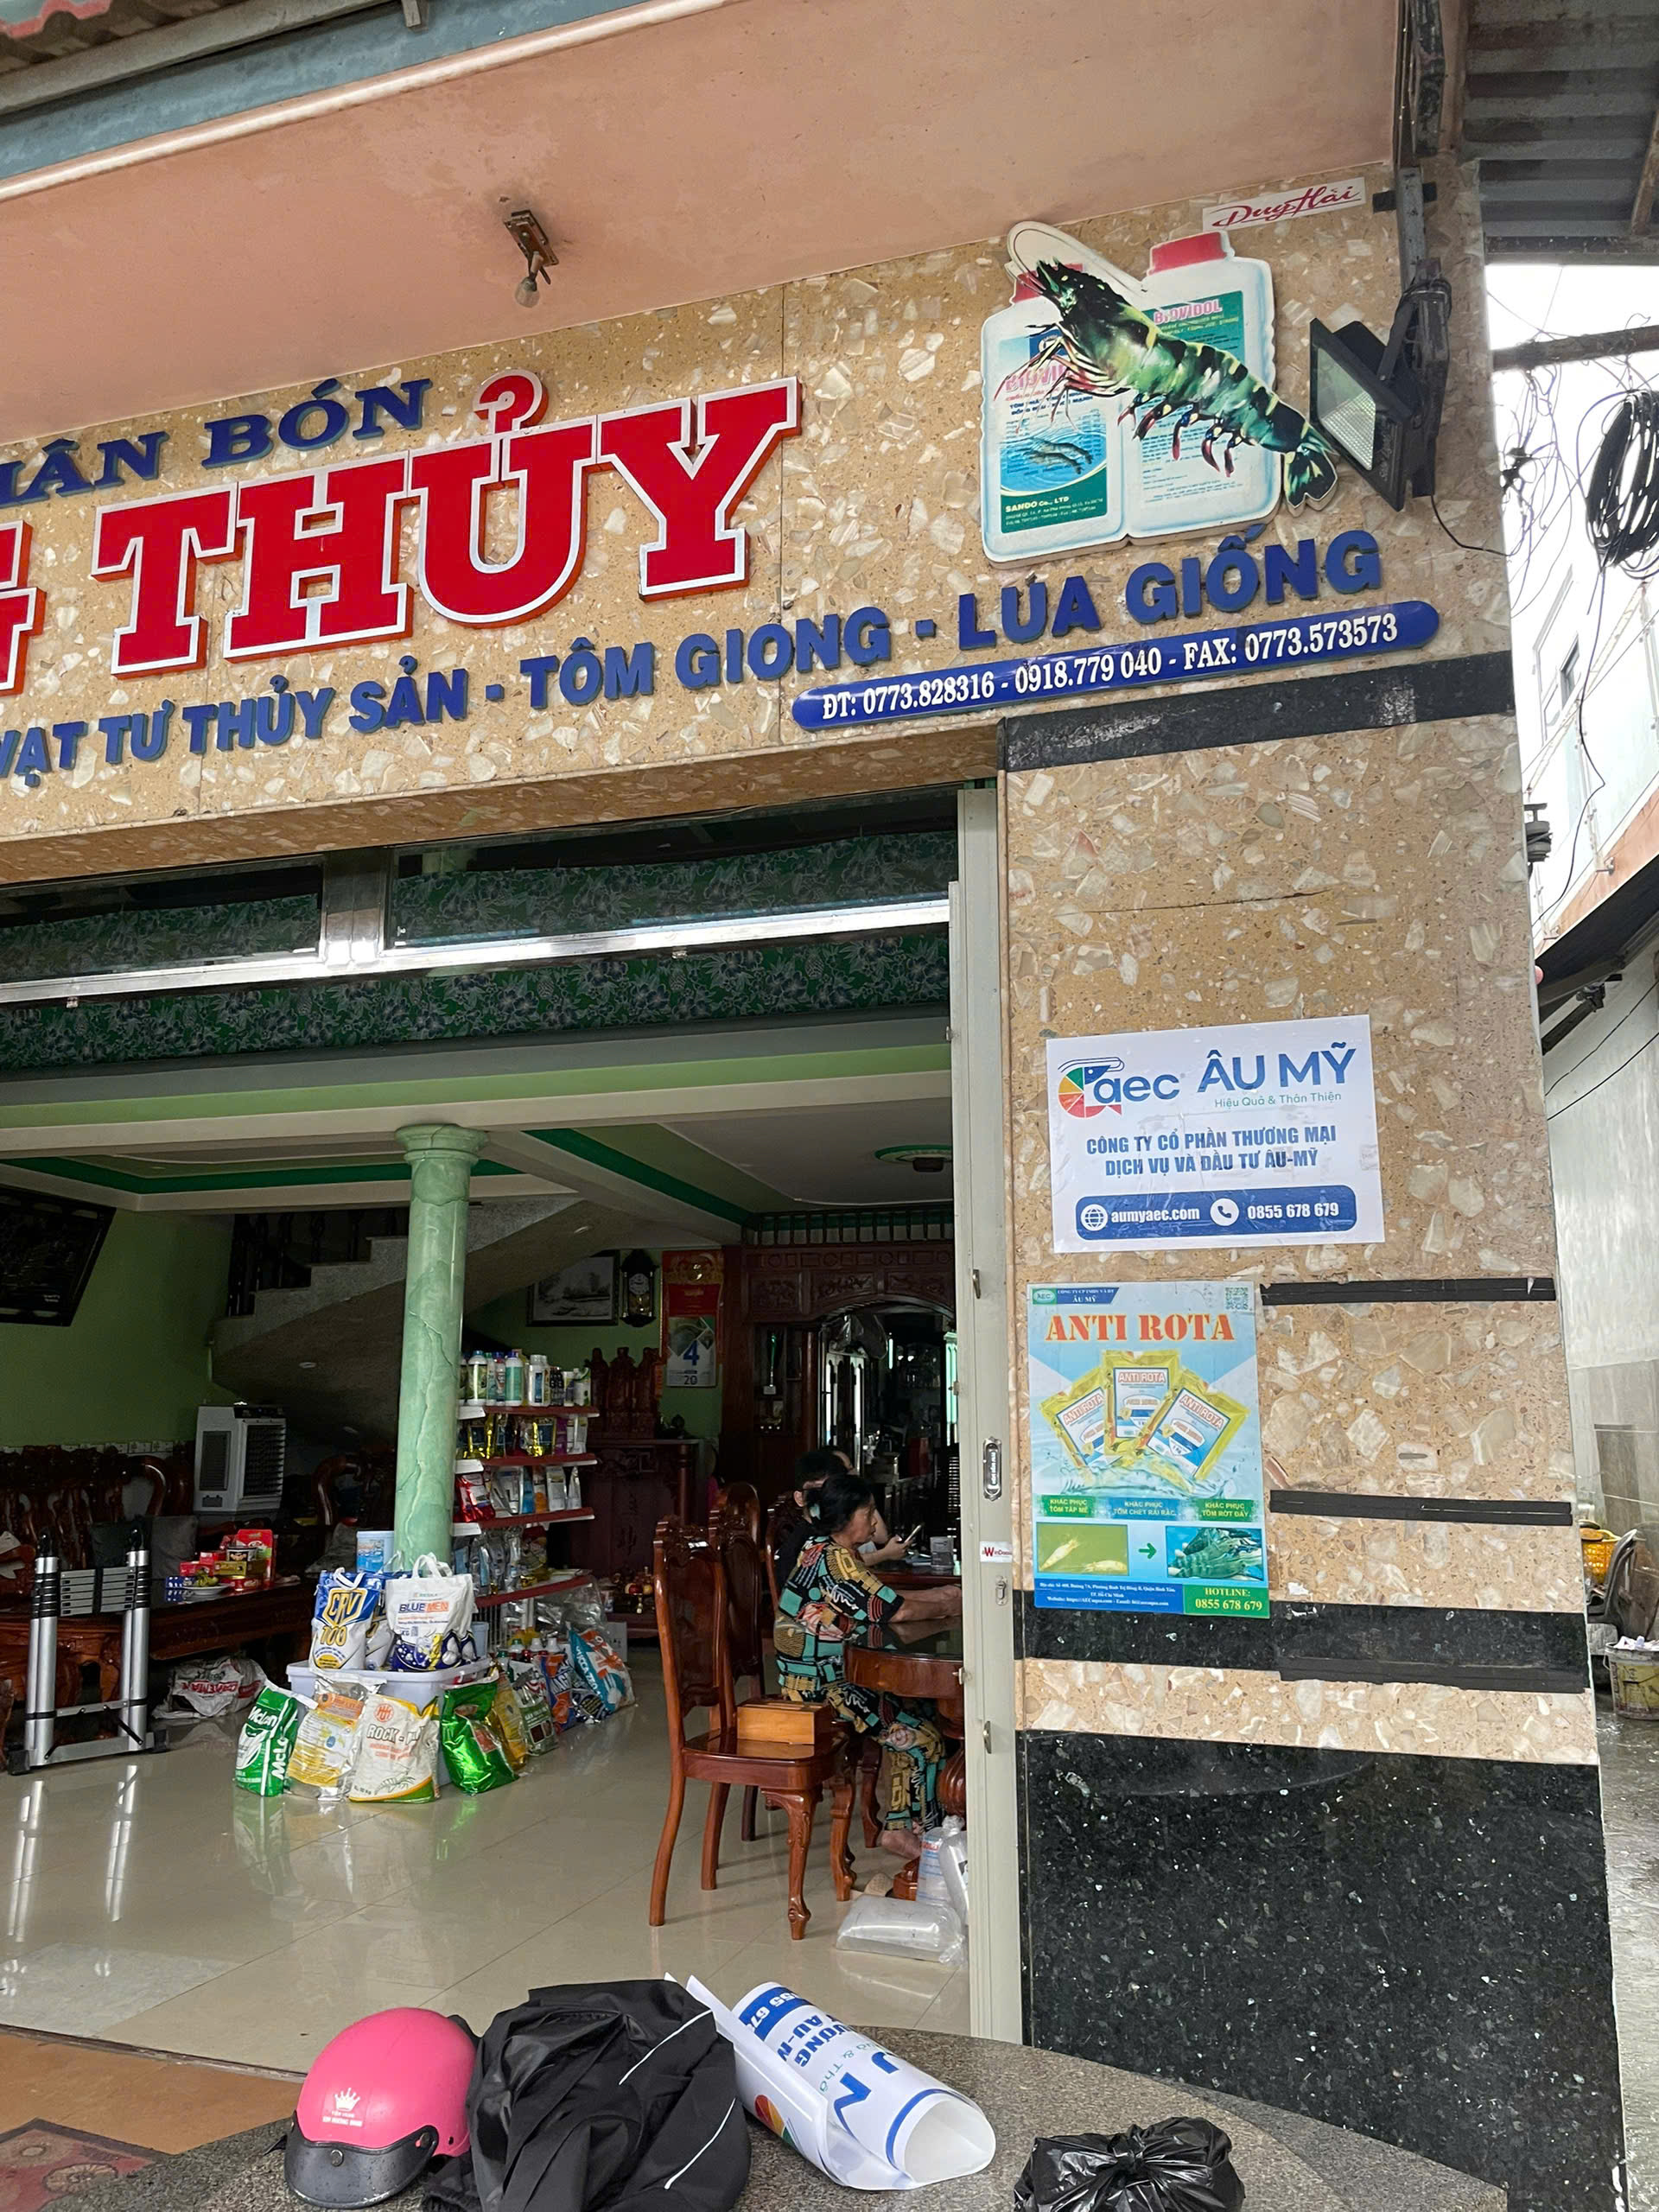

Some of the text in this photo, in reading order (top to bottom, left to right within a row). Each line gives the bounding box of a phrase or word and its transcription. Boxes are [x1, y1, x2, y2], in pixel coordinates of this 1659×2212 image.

[201, 378, 433, 469] BÓN
[1005, 501, 1038, 513] SANDO
[91, 369, 803, 680] THỦY
[99, 699, 175, 764] TƯ
[182, 675, 335, 754] THỦY
[349, 655, 469, 733] SẢN
[520, 637, 654, 709] TÔM
[1125, 523, 1382, 624] GIỐNG
[822, 693, 857, 720] ĐT:
[863, 671, 995, 715] 0773.828316
[1015, 654, 1115, 694] 0918.779
[1120, 647, 1162, 679] 040
[1184, 637, 1236, 671] FAX:
[1244, 613, 1398, 662] 0773.573573
[1197, 1042, 1357, 1092] ÂU MỸ
[1094, 1074, 1180, 1103] aec
[1215, 1098, 1239, 1109] Hiệu
[1242, 1096, 1265, 1107] Quả
[1268, 1096, 1276, 1105] &
[1311, 1092, 1342, 1103] Thiện
[1086, 1125, 1337, 1154] CÔNG TY CỔ PHẦN THƯƠNG MẠI
[1105, 1147, 1319, 1179] DỊCH VỤ VÀ ĐẦU TƯ ÂU-MỸ
[1111, 1208, 1199, 1224] aumyaec.com
[1247, 1202, 1339, 1219] 0855 678 679
[1045, 1313, 1236, 1341] ANTI ROTA
[683, 1340, 700, 1366] 4
[1118, 1372, 1166, 1382] ANTI ROTA
[1062, 1407, 1082, 1426] ANTI
[1180, 1395, 1200, 1415] ANTI
[1200, 1407, 1225, 1428] ROTA
[1195, 1599, 1262, 1611] 0855 678 679
[1205, 1587, 1251, 1597] HOTLINE:
[367, 1724, 399, 1743] ROCK
